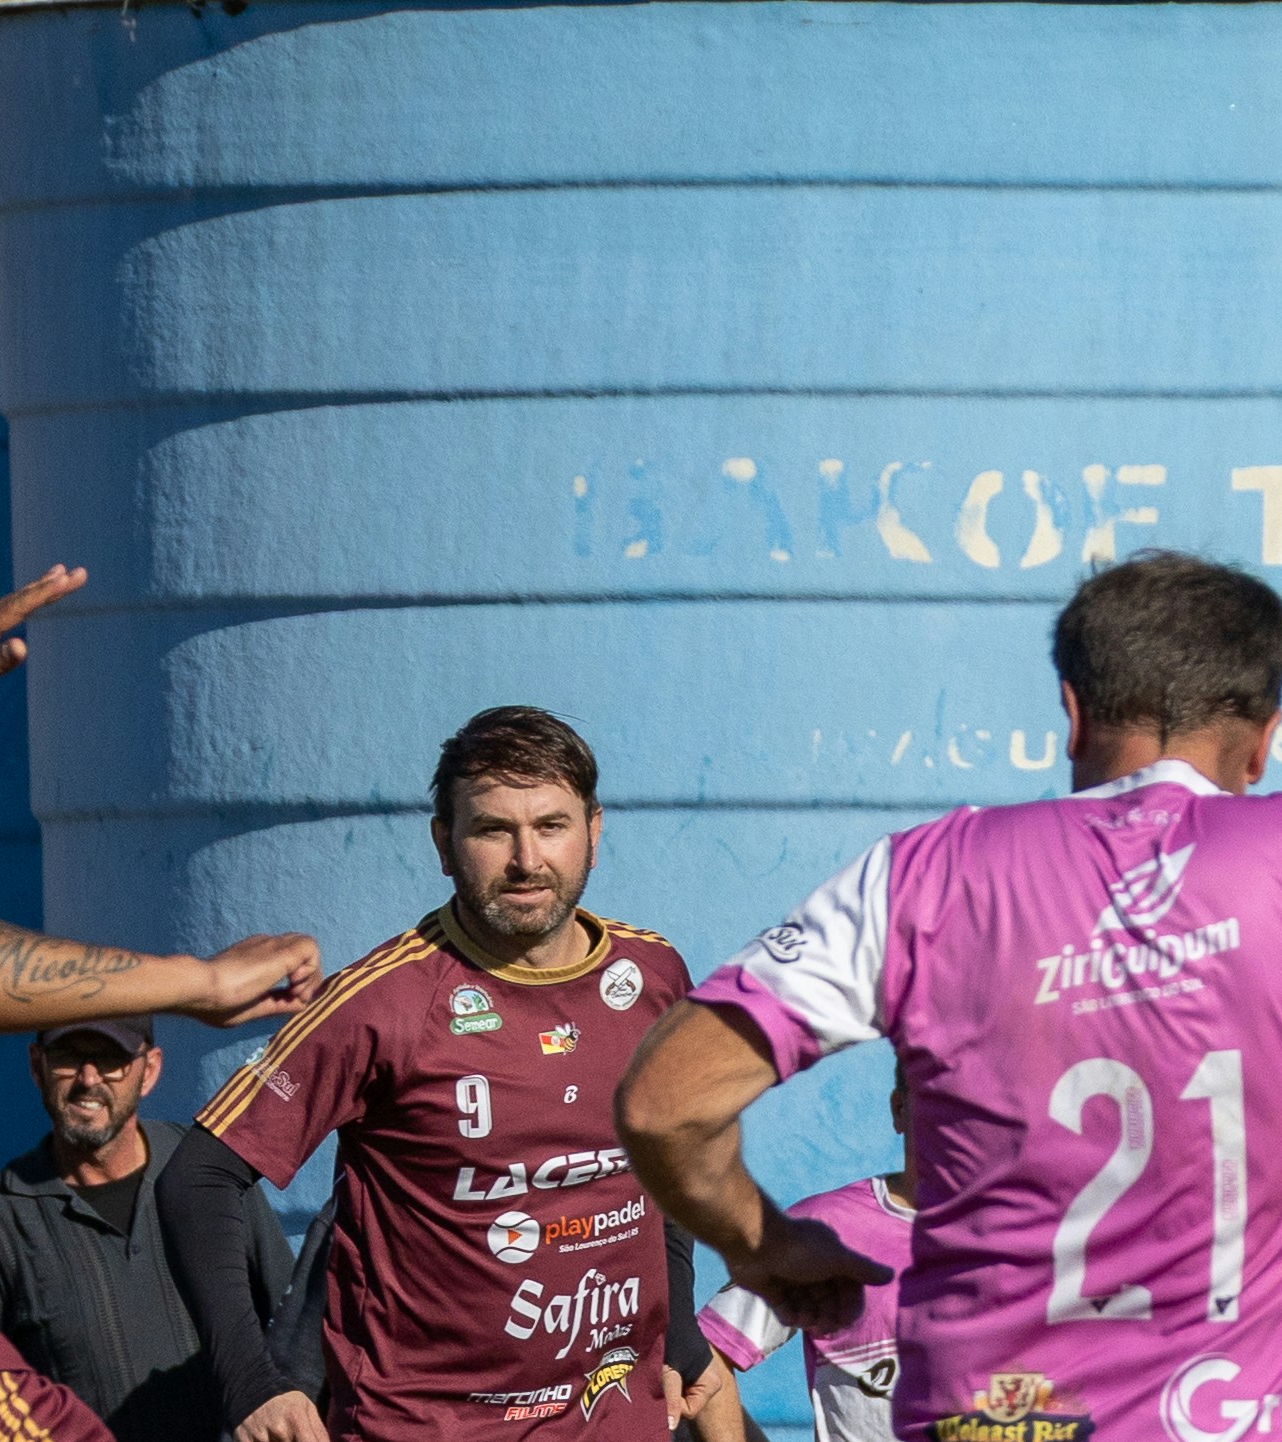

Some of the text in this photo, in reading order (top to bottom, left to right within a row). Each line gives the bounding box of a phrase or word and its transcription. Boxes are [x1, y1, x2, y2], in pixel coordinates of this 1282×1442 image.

[455, 1074, 492, 1139] 9
[544, 1195, 646, 1245] playpadel
[1046, 1049, 1249, 1325] 21
[504, 1268, 640, 1360] Safira
